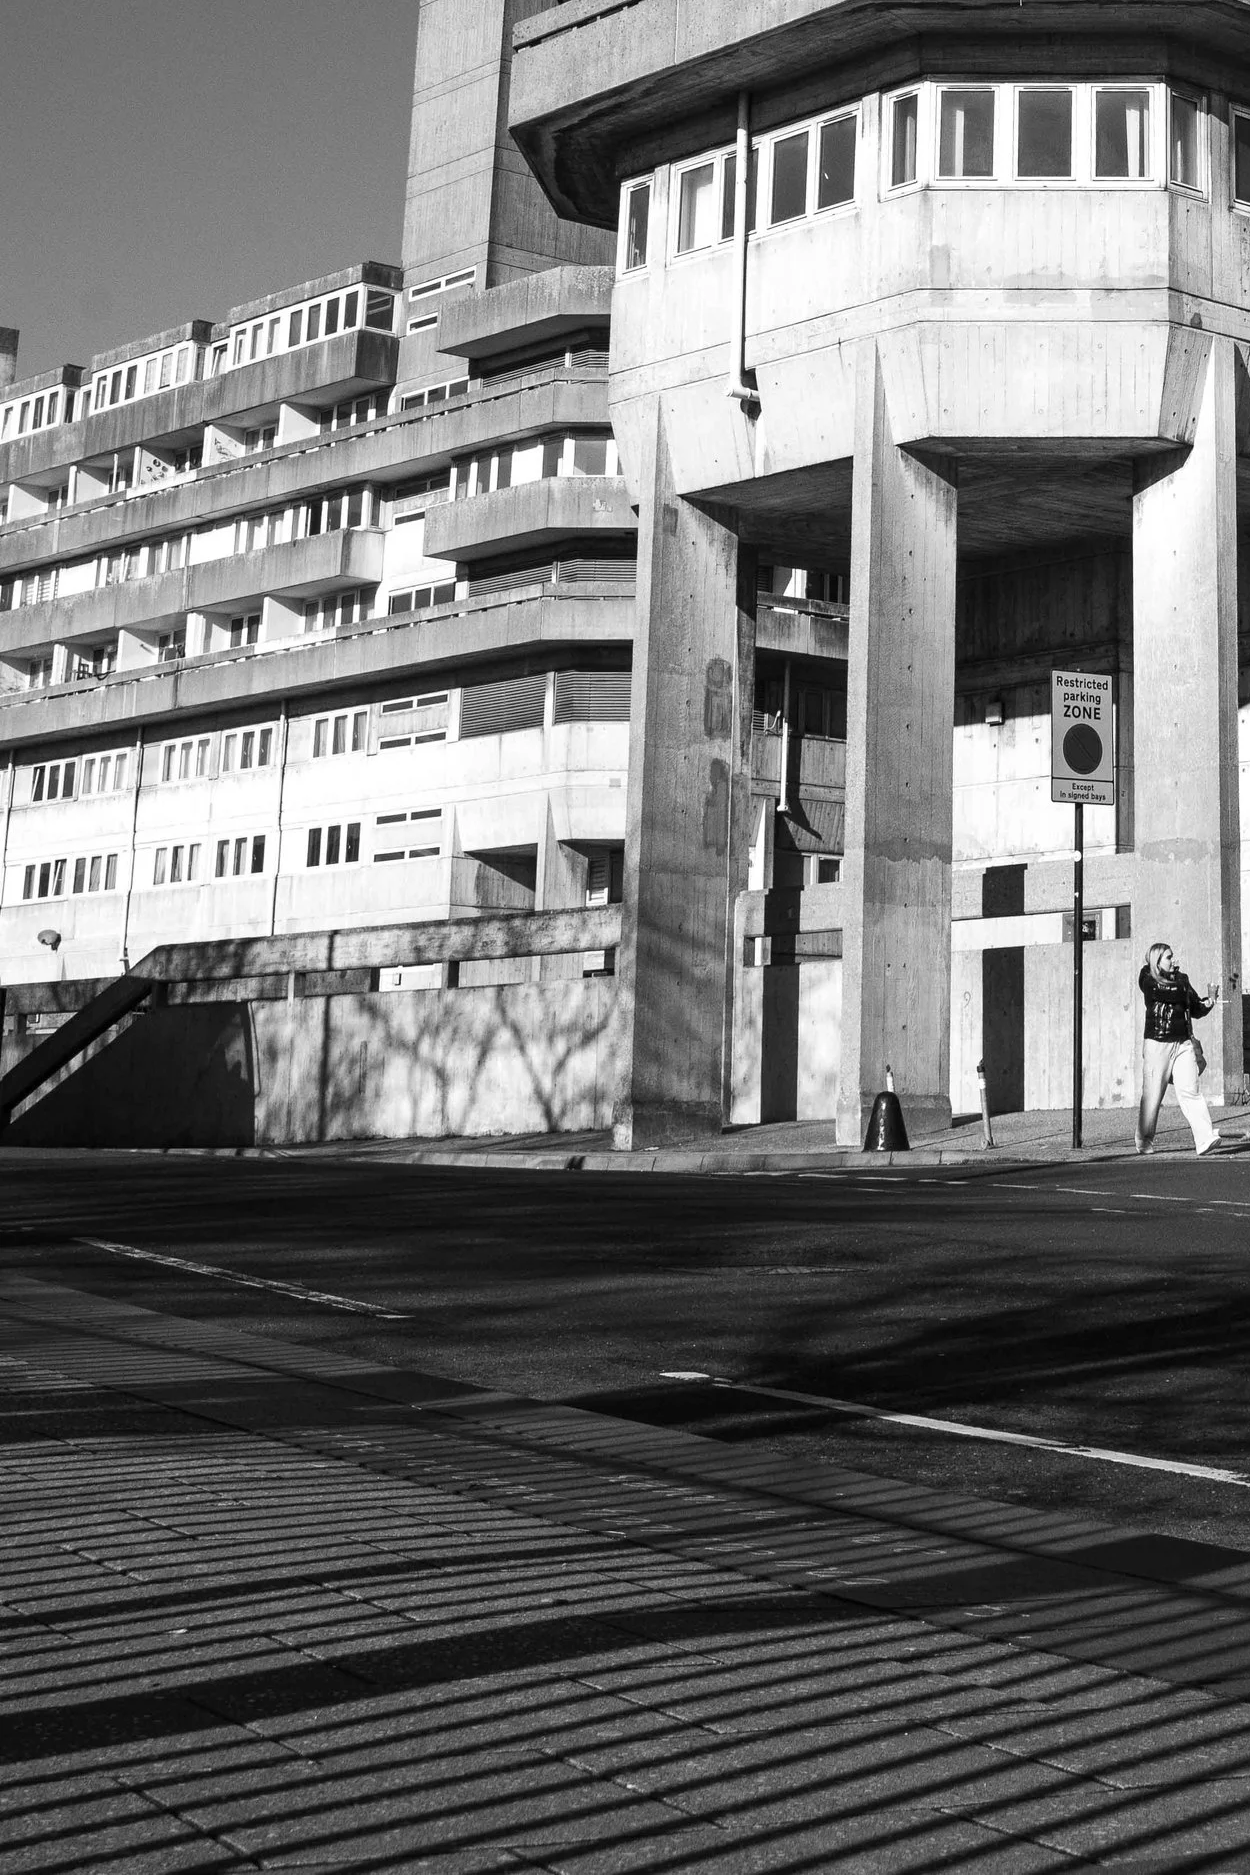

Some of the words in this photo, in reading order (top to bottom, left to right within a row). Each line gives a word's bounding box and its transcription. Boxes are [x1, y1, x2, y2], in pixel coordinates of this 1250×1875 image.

[1056, 676, 1108, 690] Restricted
[1063, 691, 1101, 705] parking
[1063, 705, 1101, 720] ZONE
[1072, 782, 1094, 791] Except
[1068, 791, 1089, 800] signed
[1091, 792, 1106, 802] bays
